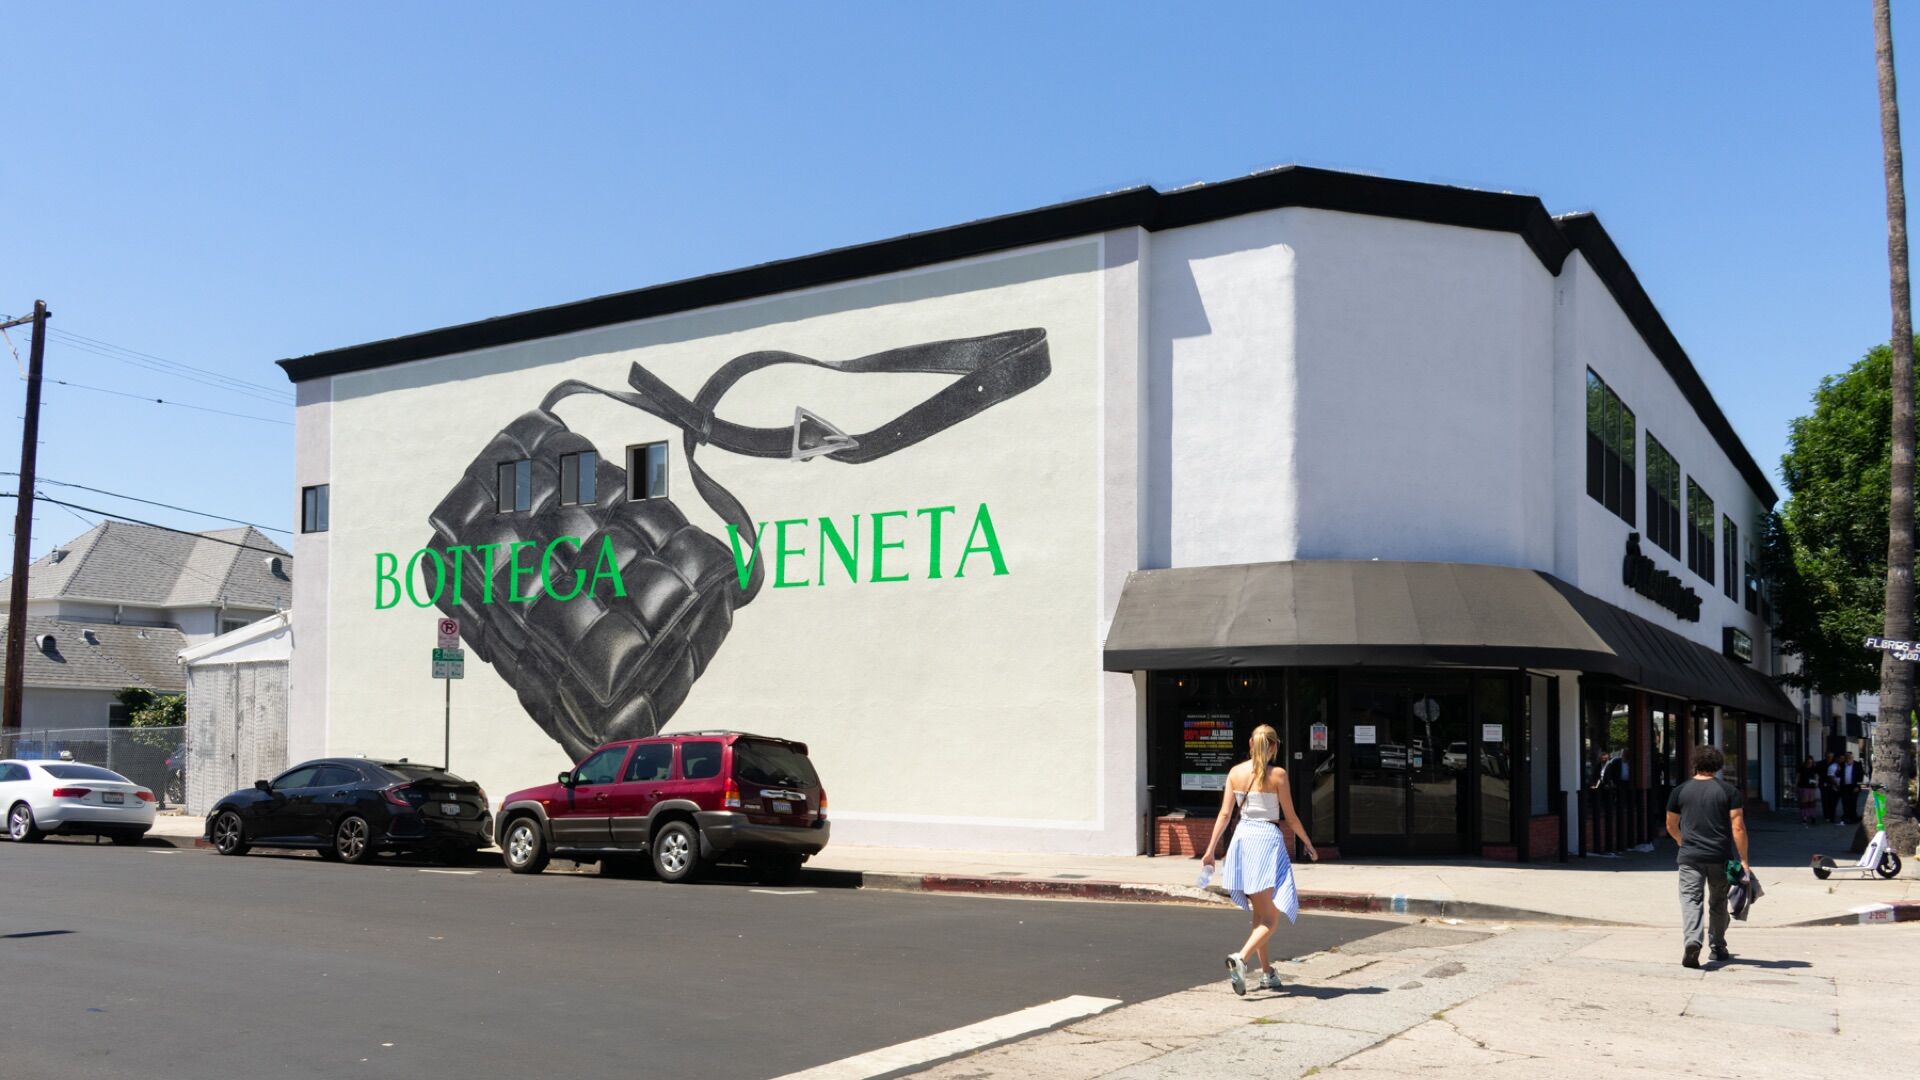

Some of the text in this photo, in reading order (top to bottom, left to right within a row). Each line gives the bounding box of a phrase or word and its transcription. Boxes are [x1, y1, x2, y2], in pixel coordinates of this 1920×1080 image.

[375, 503, 1009, 610] BOTTEGA VENETA
[1866, 638, 1909, 650] FLORES
